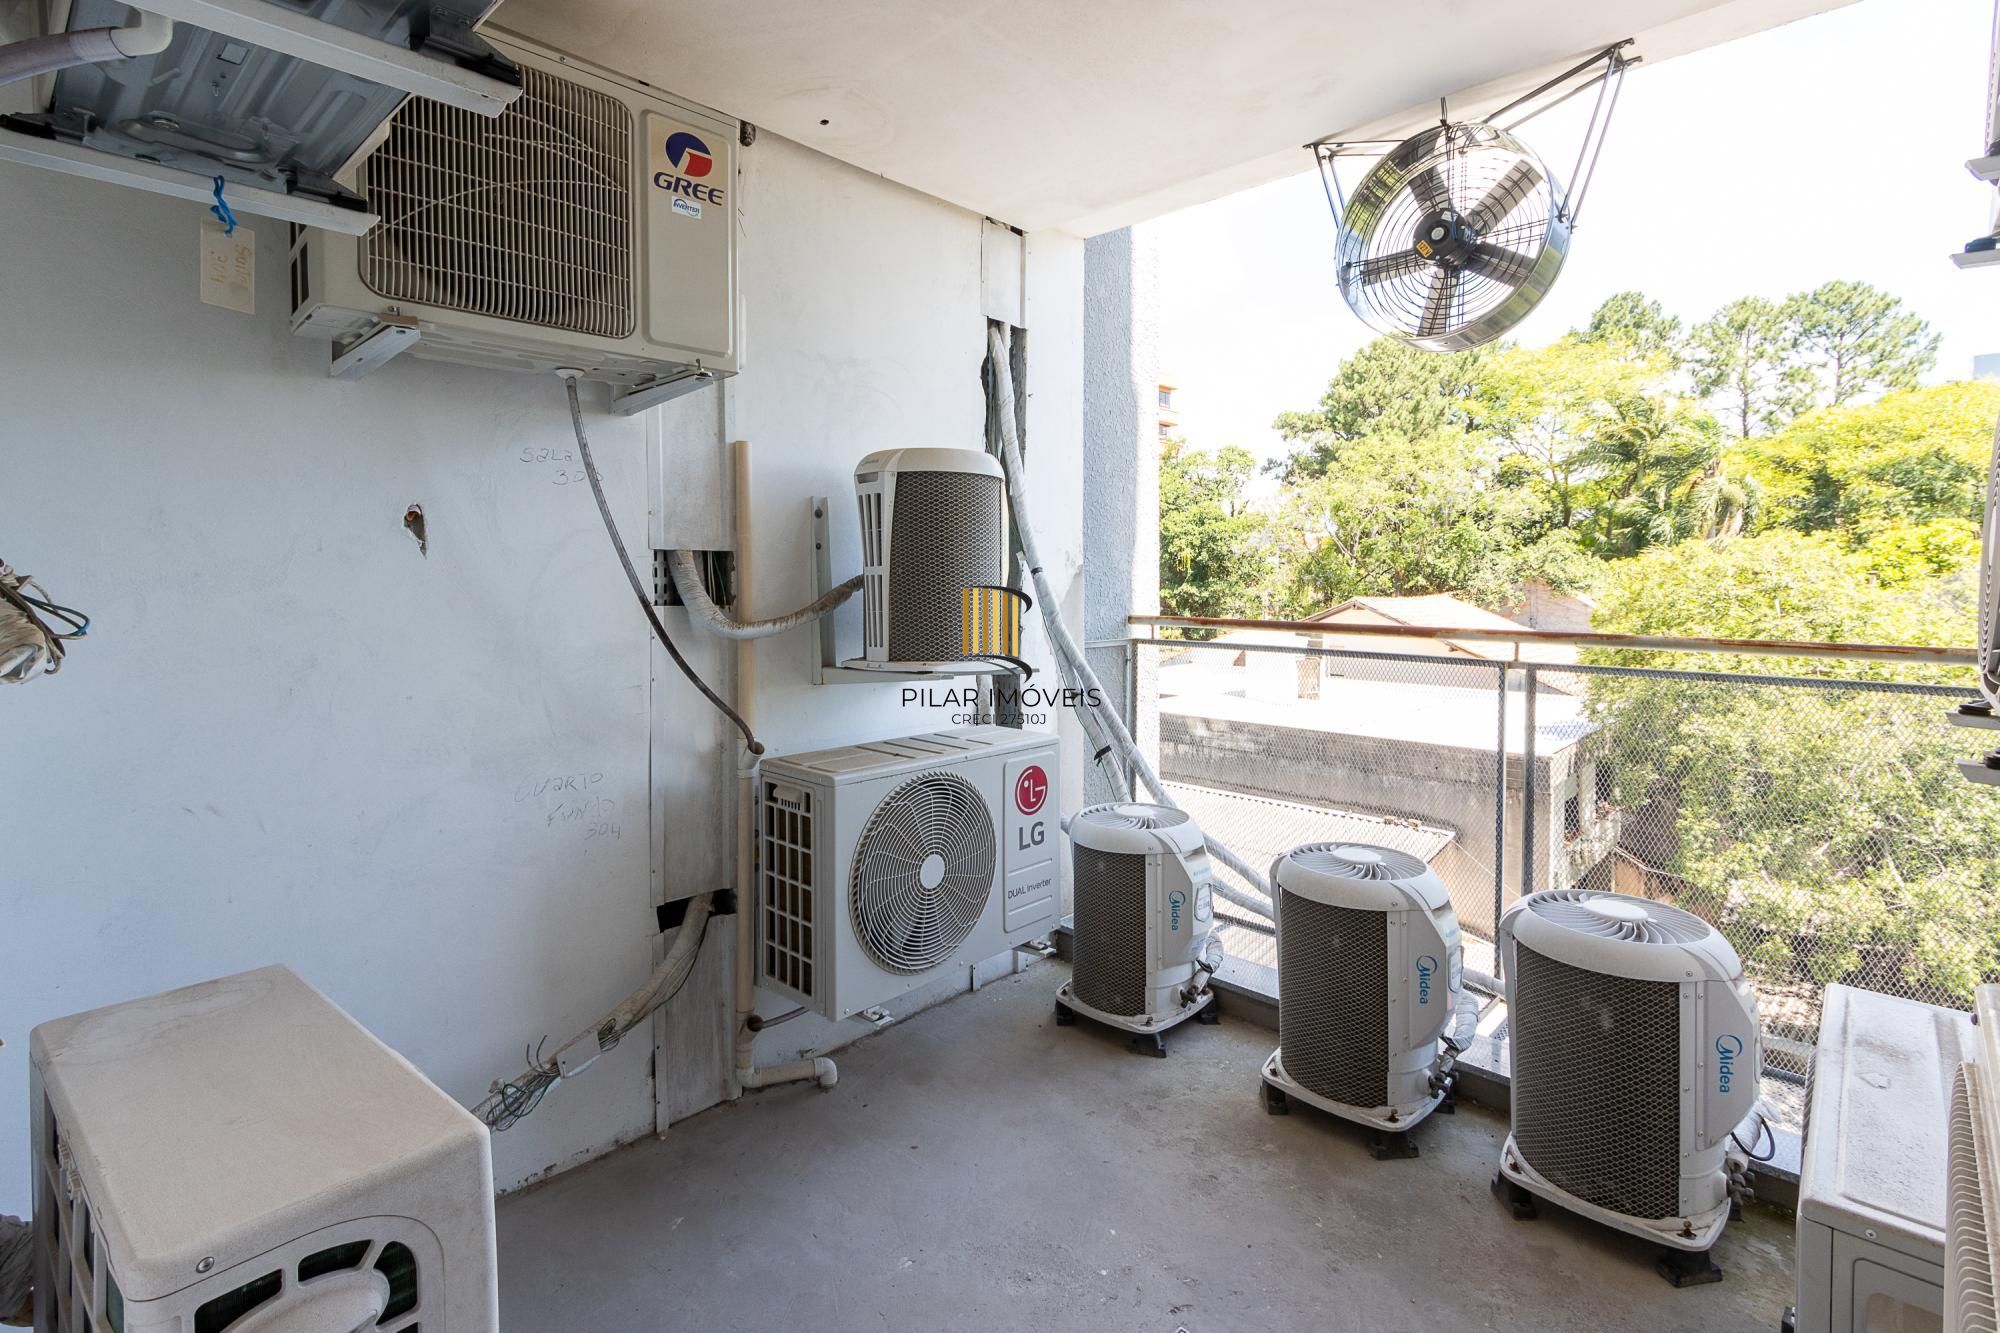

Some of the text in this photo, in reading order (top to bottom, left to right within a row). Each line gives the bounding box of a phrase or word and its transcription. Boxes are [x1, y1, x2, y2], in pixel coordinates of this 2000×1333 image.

[653, 171, 726, 207] GREE
[1018, 821, 1045, 851] LG
[1007, 878, 1053, 899] DUAL Inverter
[1169, 891, 1186, 931] Midea
[1416, 955, 1438, 1005] Midea
[1715, 1034, 1743, 1093] Midea
